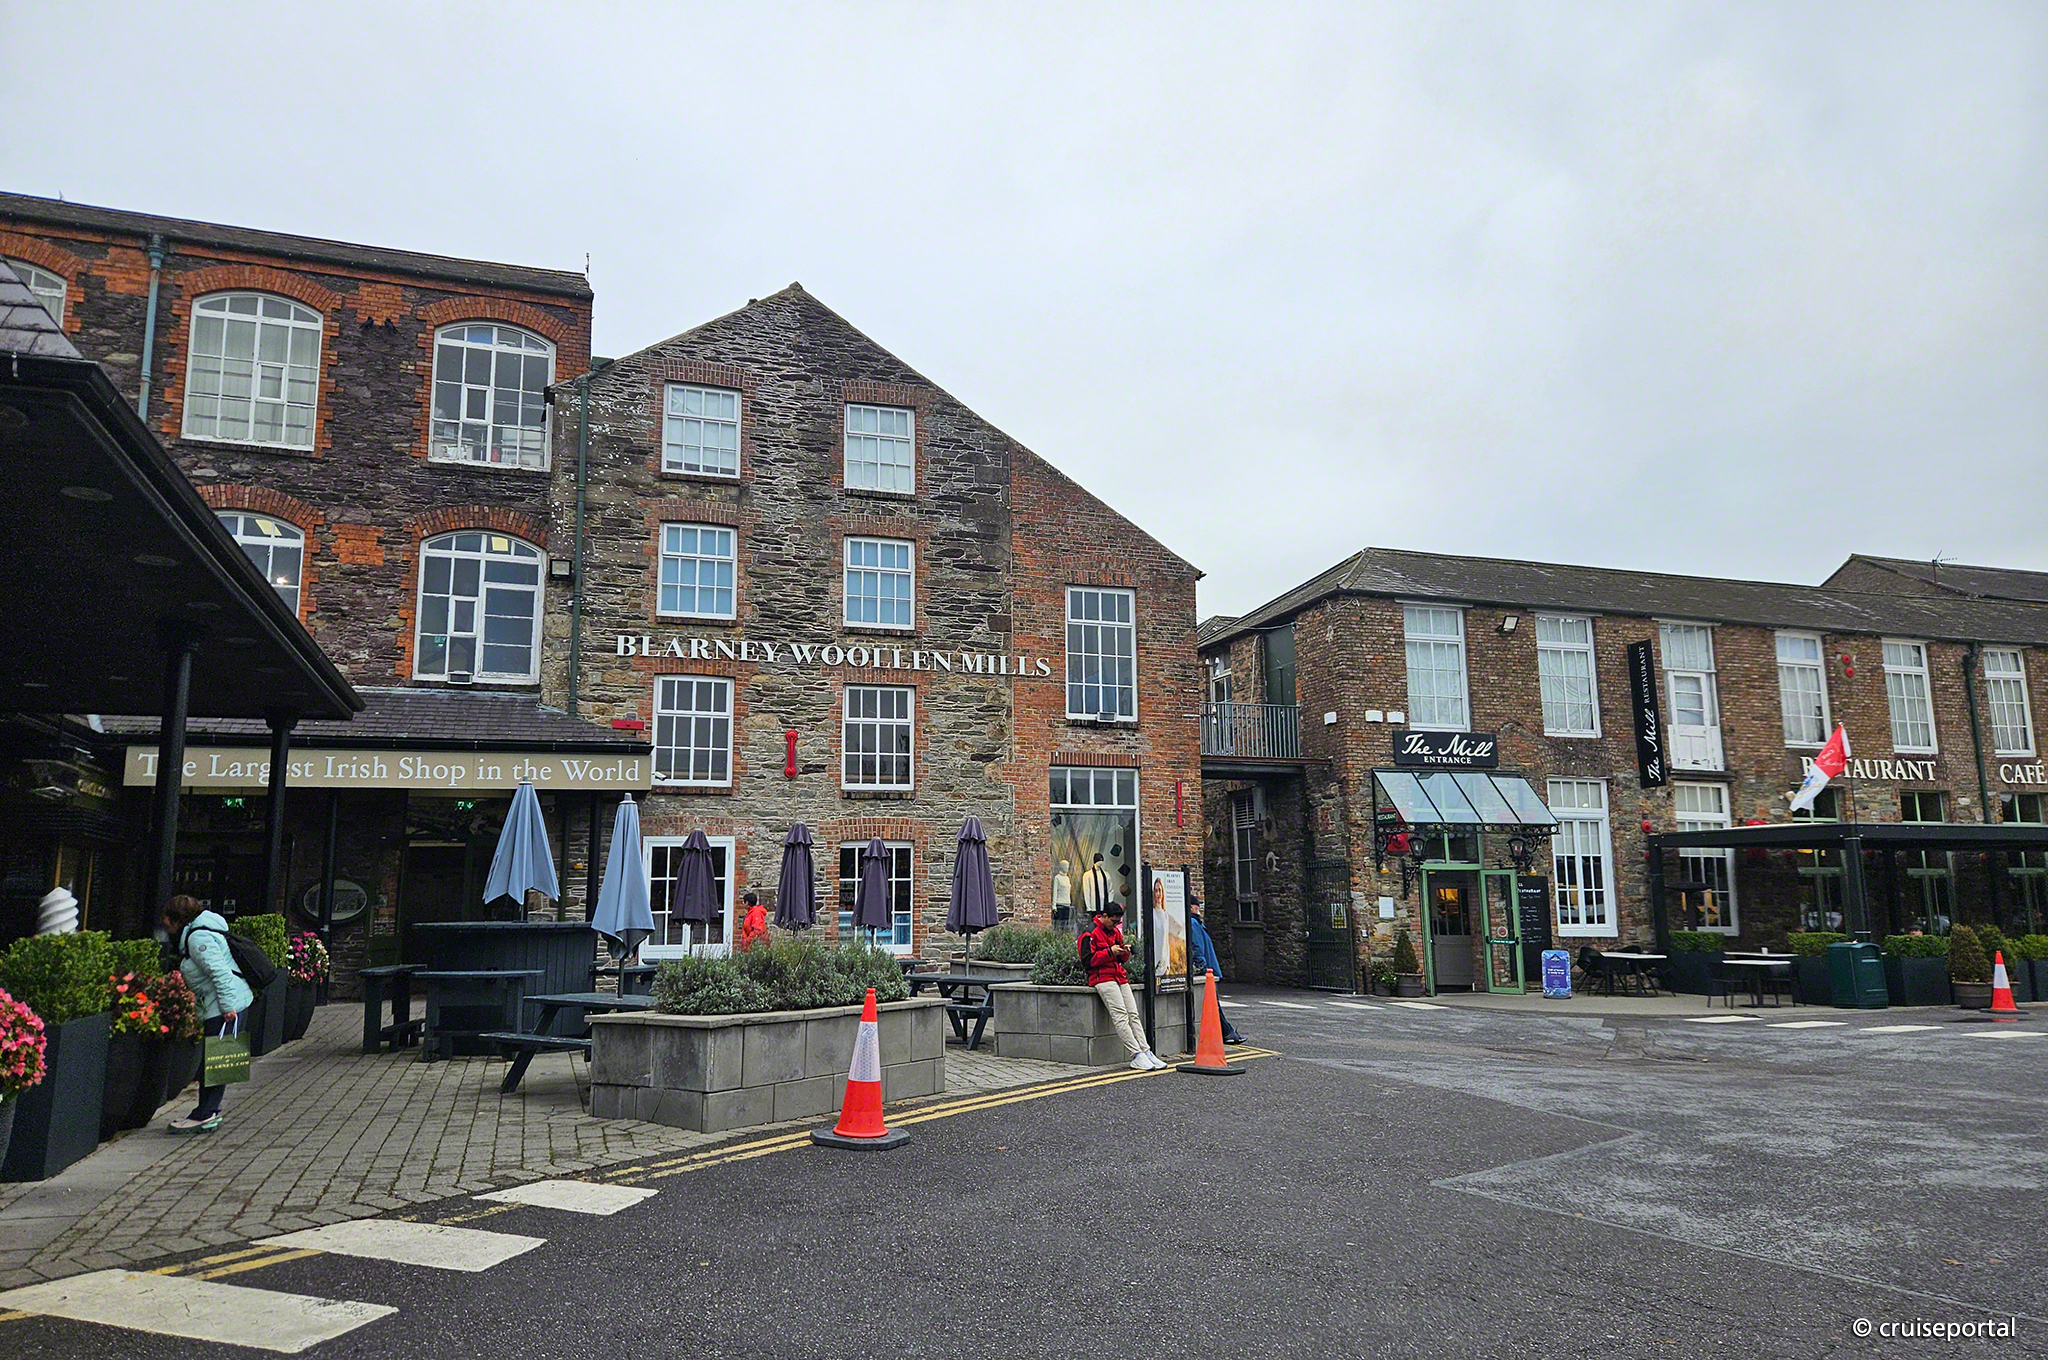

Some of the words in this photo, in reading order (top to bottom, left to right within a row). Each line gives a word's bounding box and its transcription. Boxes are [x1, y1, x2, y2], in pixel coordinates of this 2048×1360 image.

[615, 635, 782, 662] BLARNEY
[789, 643, 951, 672] WOOLLEN
[961, 653, 1051, 677] MILLS
[1638, 646, 1650, 704] RESTAURANT
[1643, 708, 1657, 752] Mill
[1401, 733, 1433, 754] The
[1438, 733, 1494, 757] Mill
[138, 753, 197, 778] Te
[207, 754, 314, 785] Largst
[323, 756, 389, 779] Irish
[398, 757, 466, 786] Shop
[477, 758, 502, 780] in
[512, 758, 552, 781] the
[561, 759, 640, 783] World
[1424, 755, 1472, 764] ENTRANCE
[1646, 756, 1662, 782] The
[1800, 756, 1937, 781] RTAURANT
[2000, 759, 2048, 784] CAFÉ
